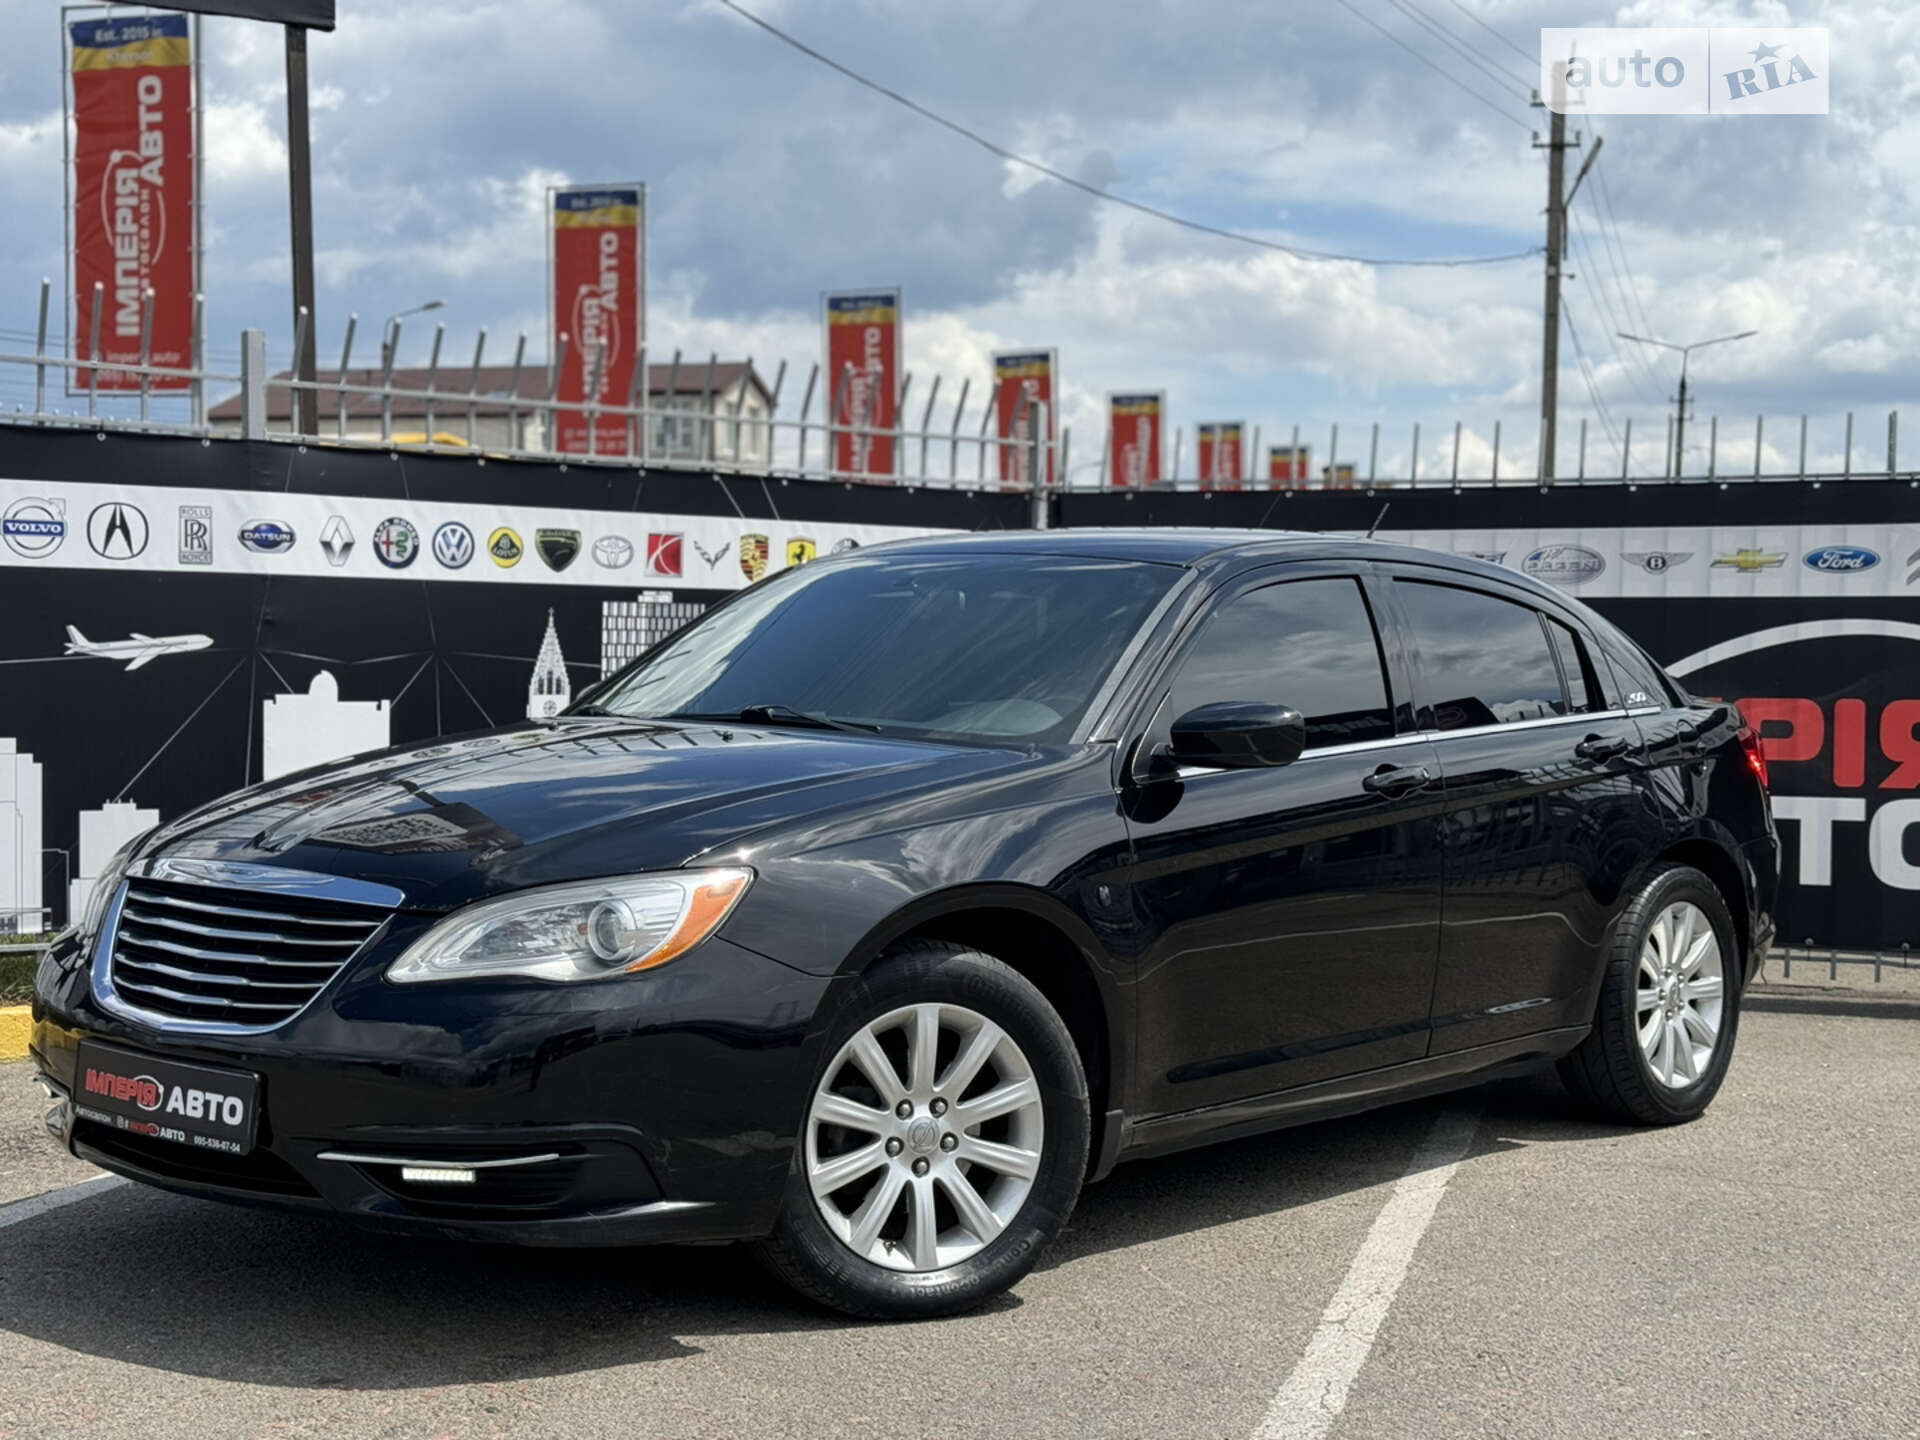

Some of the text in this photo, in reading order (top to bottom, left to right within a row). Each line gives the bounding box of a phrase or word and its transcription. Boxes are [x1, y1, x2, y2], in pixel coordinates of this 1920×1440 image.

[138, 75, 163, 187] АВТО
[115, 167, 141, 337] ІМПЕРІЯ
[599, 231, 619, 311] АВТО
[5, 521, 62, 535] VOLVO
[243, 531, 291, 541] DATSUN
[1817, 550, 1866, 569] Ford
[84, 1068, 244, 1126] ІМПЕРІЯ АВТО
